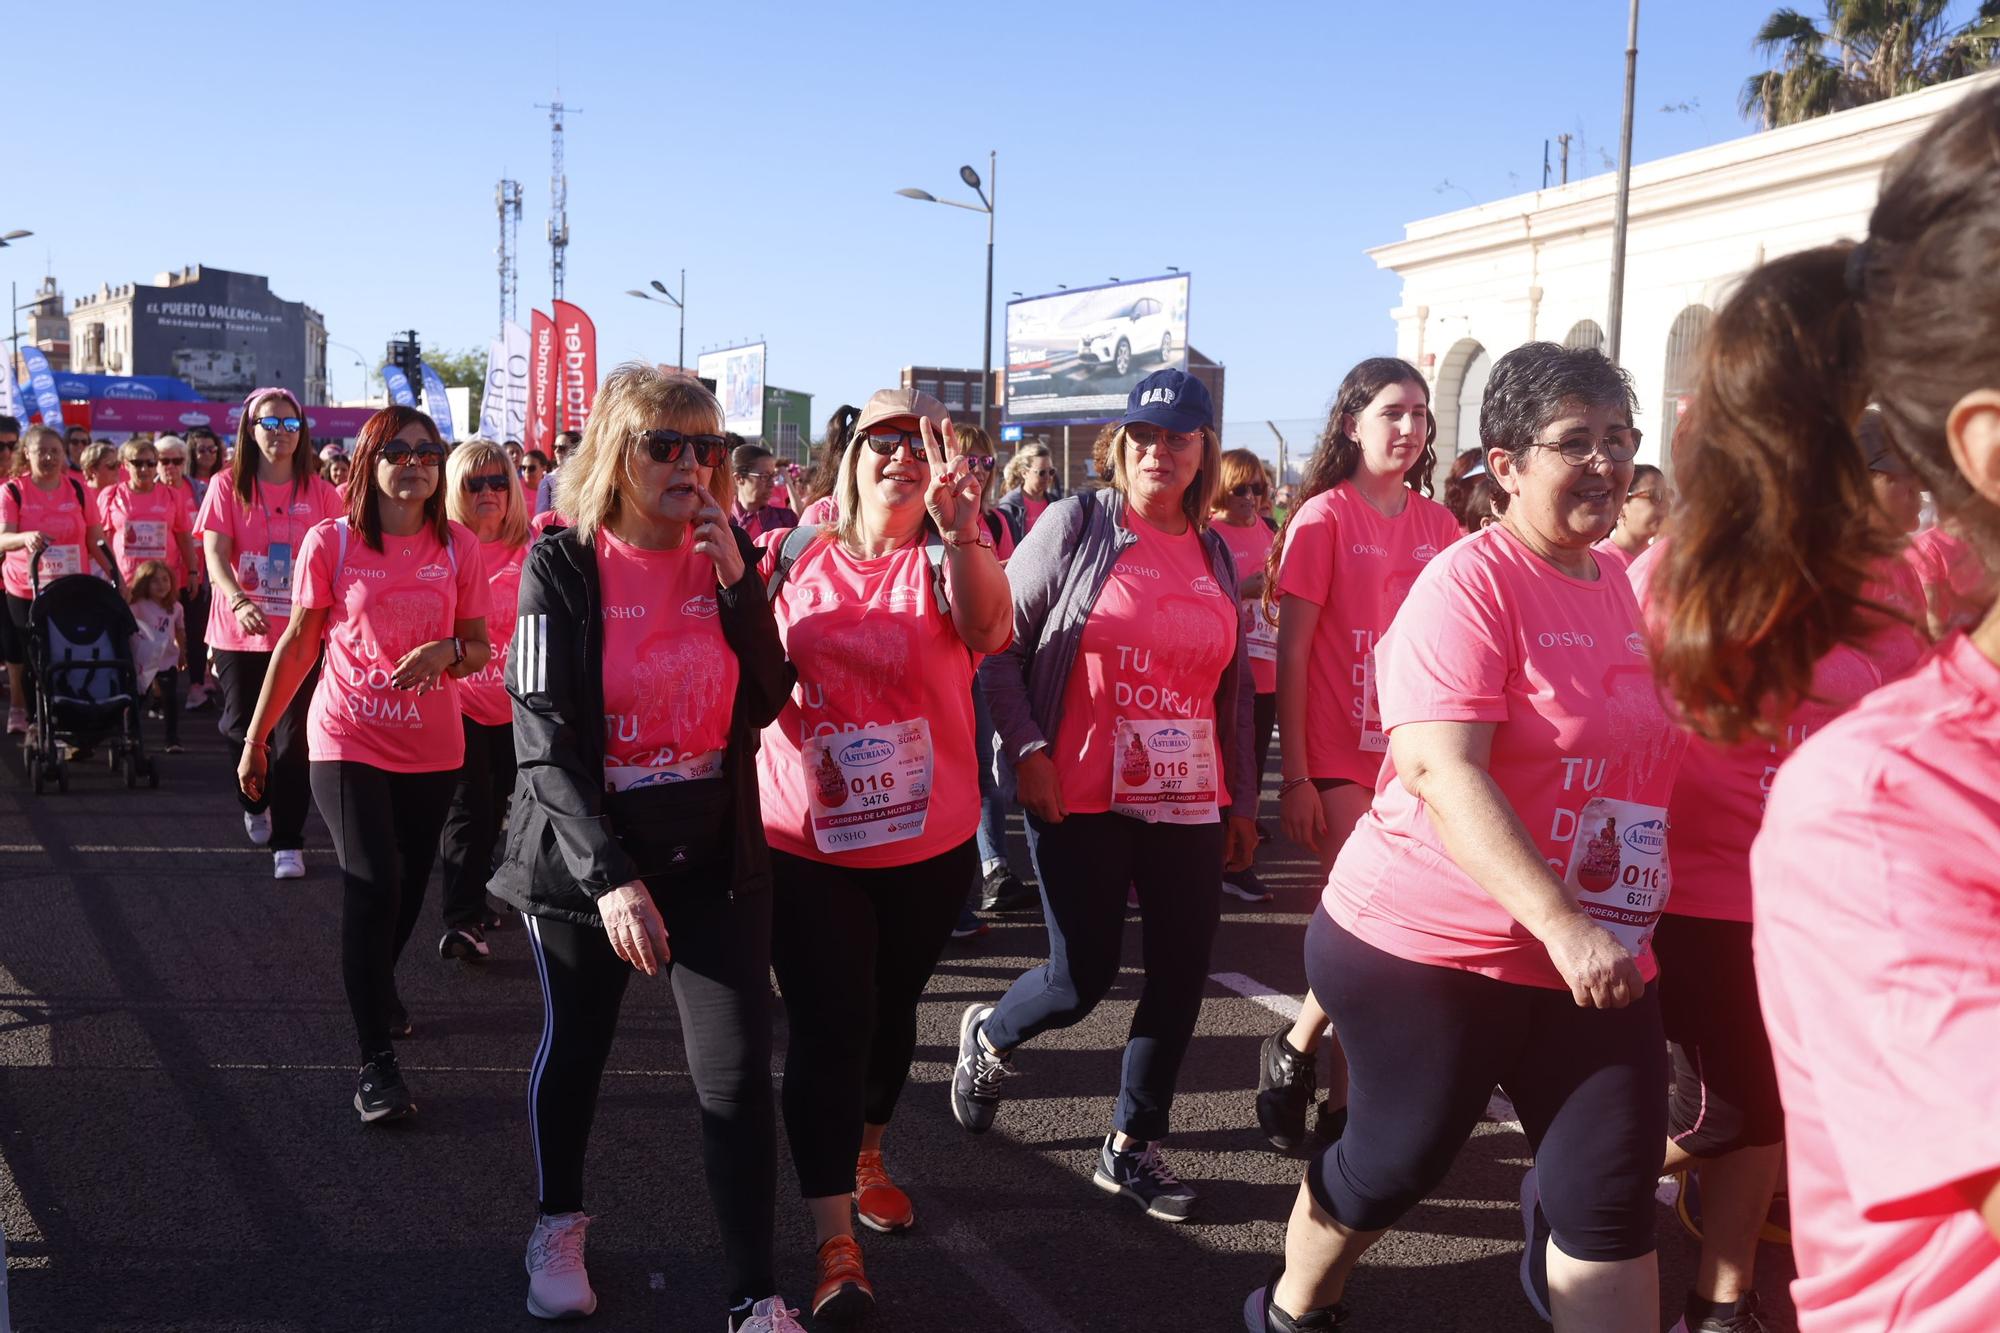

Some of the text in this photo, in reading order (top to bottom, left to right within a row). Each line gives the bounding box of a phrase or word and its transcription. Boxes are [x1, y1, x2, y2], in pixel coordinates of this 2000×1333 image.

[162, 302, 206, 318] PUERTO
[343, 566, 386, 579] OYSHO
[1115, 562, 1160, 579] OYSHO
[601, 605, 646, 620] YSHO
[1538, 631, 1594, 648] OYSHO
[351, 639, 378, 660] TU
[1117, 645, 1150, 673] TU
[348, 692, 421, 721] SUMA
[898, 734, 921, 745] SUMA
[1370, 736, 1389, 745] OYS
[843, 750, 892, 763] ASTURIANA
[690, 765, 714, 778] SUMA
[1153, 761, 1188, 777] 016
[1561, 757, 1606, 792] TU
[851, 773, 895, 794] 016
[1160, 780, 1183, 789] 3477
[861, 793, 890, 807] 3476
[829, 815, 863, 826] CARRERA
[864, 812, 875, 820] DE
[876, 808, 886, 818] LA
[887, 803, 912, 816] MUJER
[1121, 806, 1210, 816] OYSHO Santander
[828, 830, 867, 844] OYSHO
[1623, 864, 1659, 889] 016
[1626, 891, 1653, 906] 6211
[1583, 905, 1619, 919] ARRERA
